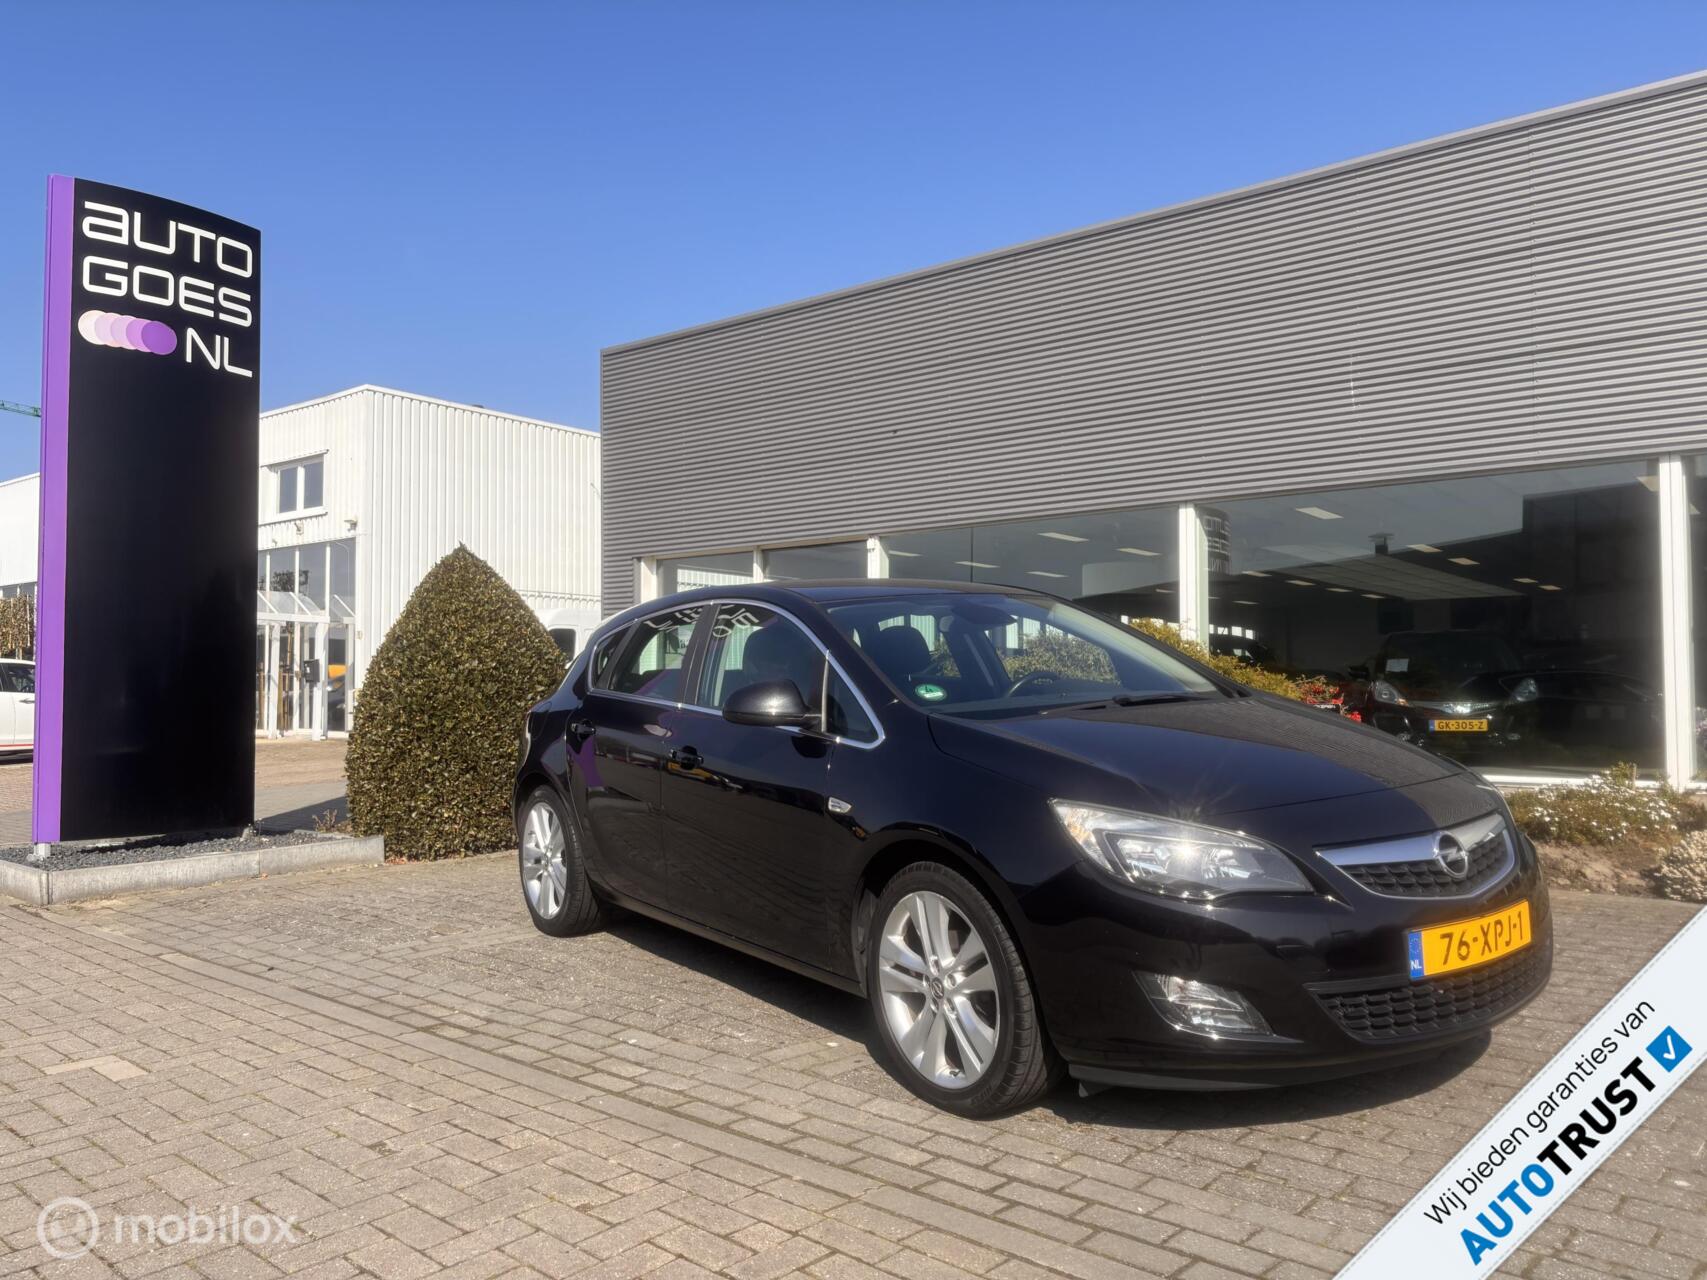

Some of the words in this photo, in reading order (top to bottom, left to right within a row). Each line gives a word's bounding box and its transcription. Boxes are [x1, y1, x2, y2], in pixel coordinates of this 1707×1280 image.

[83, 255, 253, 328] GOES
[186, 327, 253, 377] NL
[1437, 720, 1485, 730] GK-305-Z
[1439, 910, 1524, 966] 76-XPJ-1
[1410, 959, 1423, 970] NL
